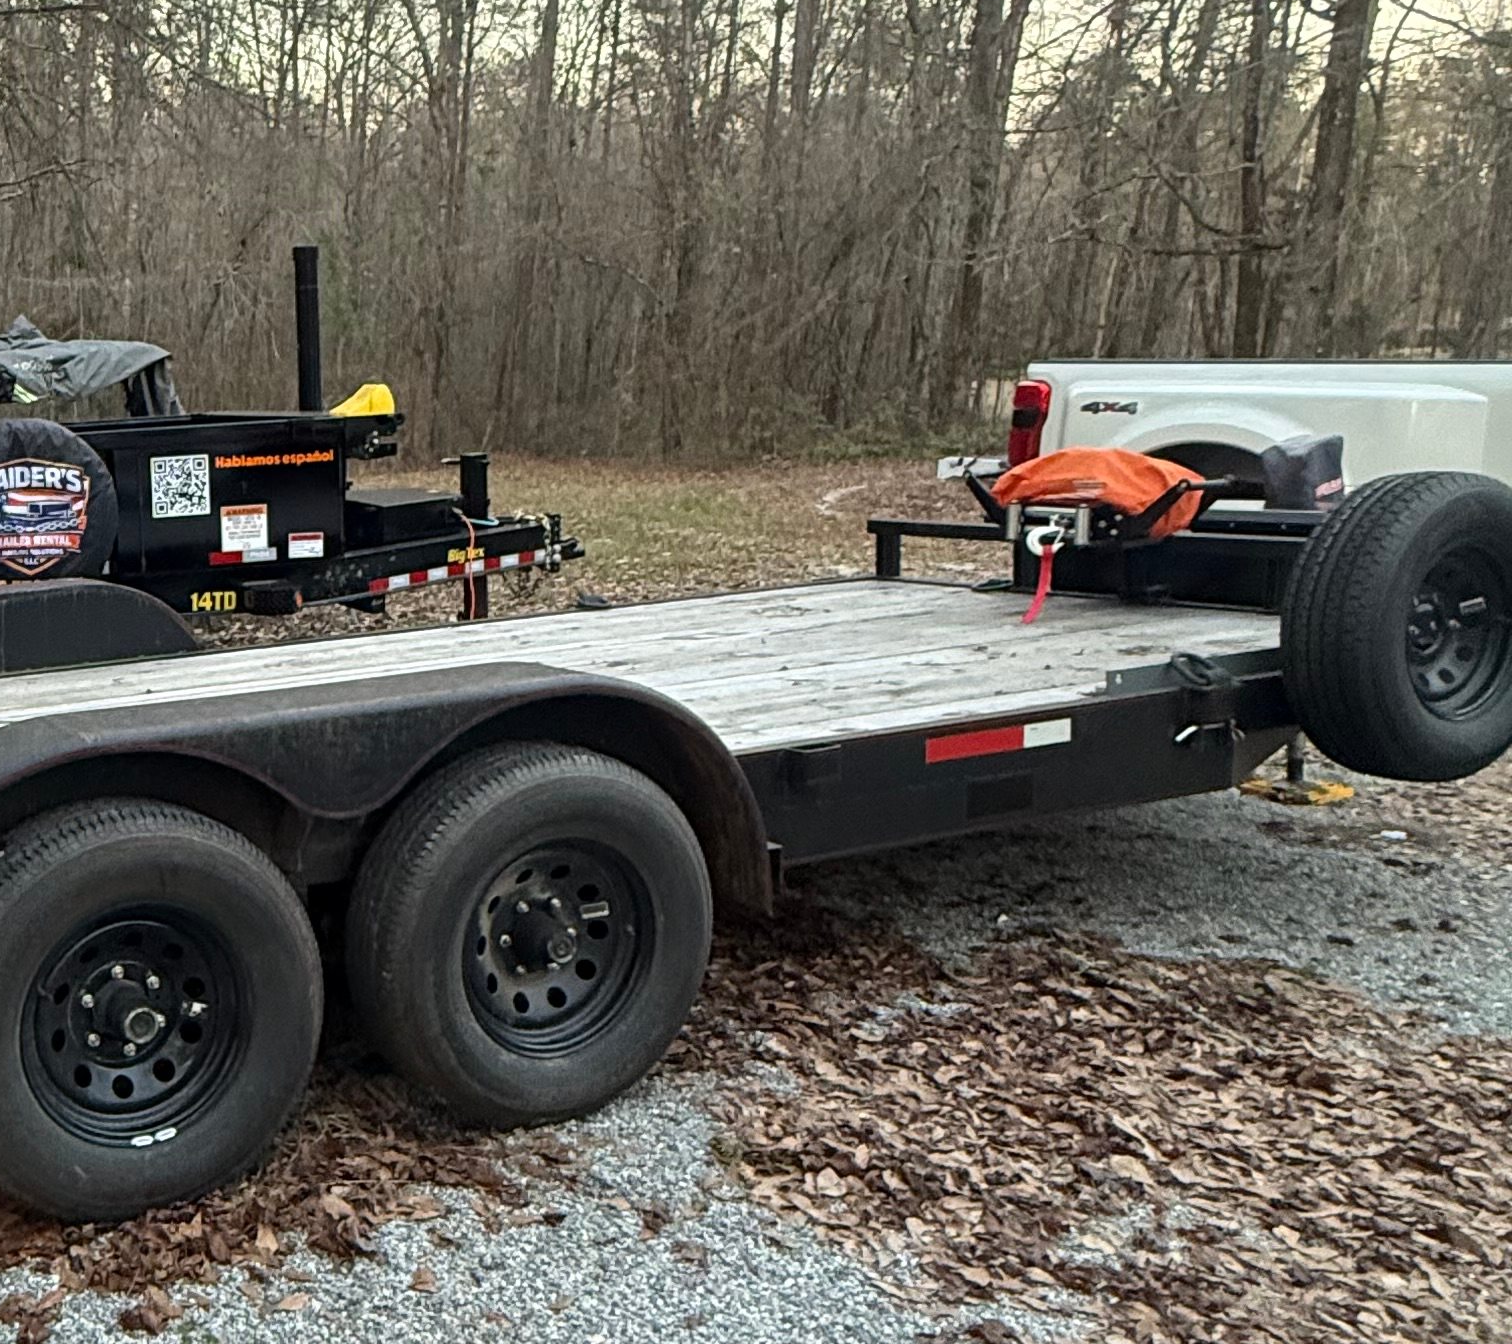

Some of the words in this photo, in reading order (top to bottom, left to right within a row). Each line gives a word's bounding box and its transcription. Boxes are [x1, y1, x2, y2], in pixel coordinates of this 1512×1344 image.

[215, 455, 281, 468] Hablamos
[282, 449, 334, 466] español
[190, 591, 237, 612] 14TD
